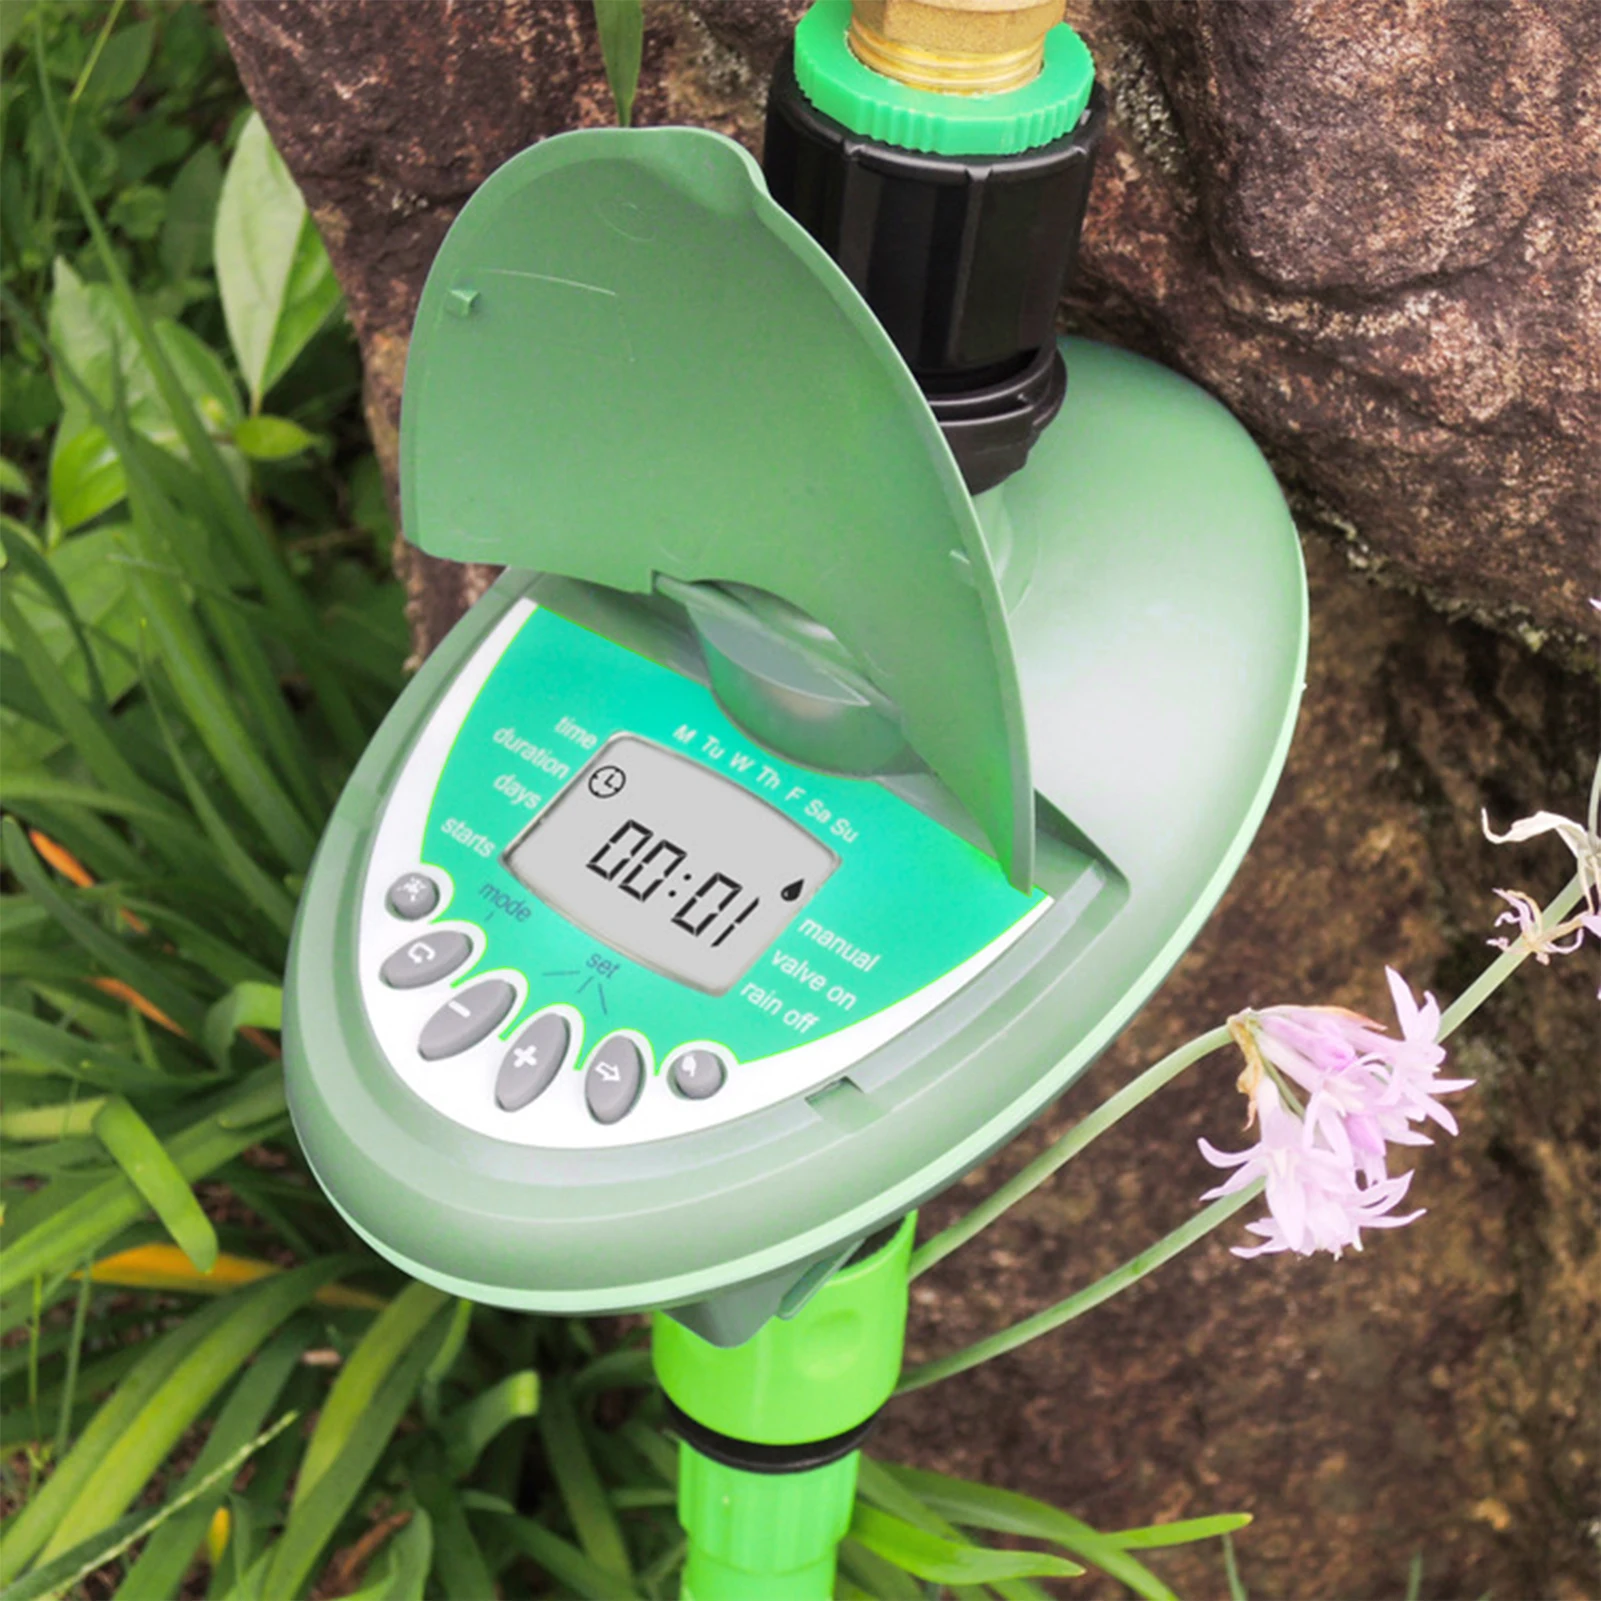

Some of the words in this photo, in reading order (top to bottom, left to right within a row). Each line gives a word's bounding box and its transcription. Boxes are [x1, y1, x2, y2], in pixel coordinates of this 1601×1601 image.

[493, 727, 571, 779] duration
[554, 716, 598, 750] time
[493, 773, 542, 810] days
[672, 723, 698, 744] M
[701, 735, 726, 759] Tu
[730, 751, 755, 772] W
[756, 765, 781, 790] Th
[785, 786, 807, 801] F
[804, 799, 832, 824] Sa
[830, 818, 860, 844] Su
[441, 817, 496, 857] starts
[479, 883, 532, 922] mode
[585, 819, 760, 947] 00:01
[585, 952, 621, 980] set
[797, 918, 882, 972] manual
[771, 949, 827, 991] valve
[826, 986, 857, 1011] on
[740, 982, 783, 1016] rain
[783, 1009, 820, 1033] off
